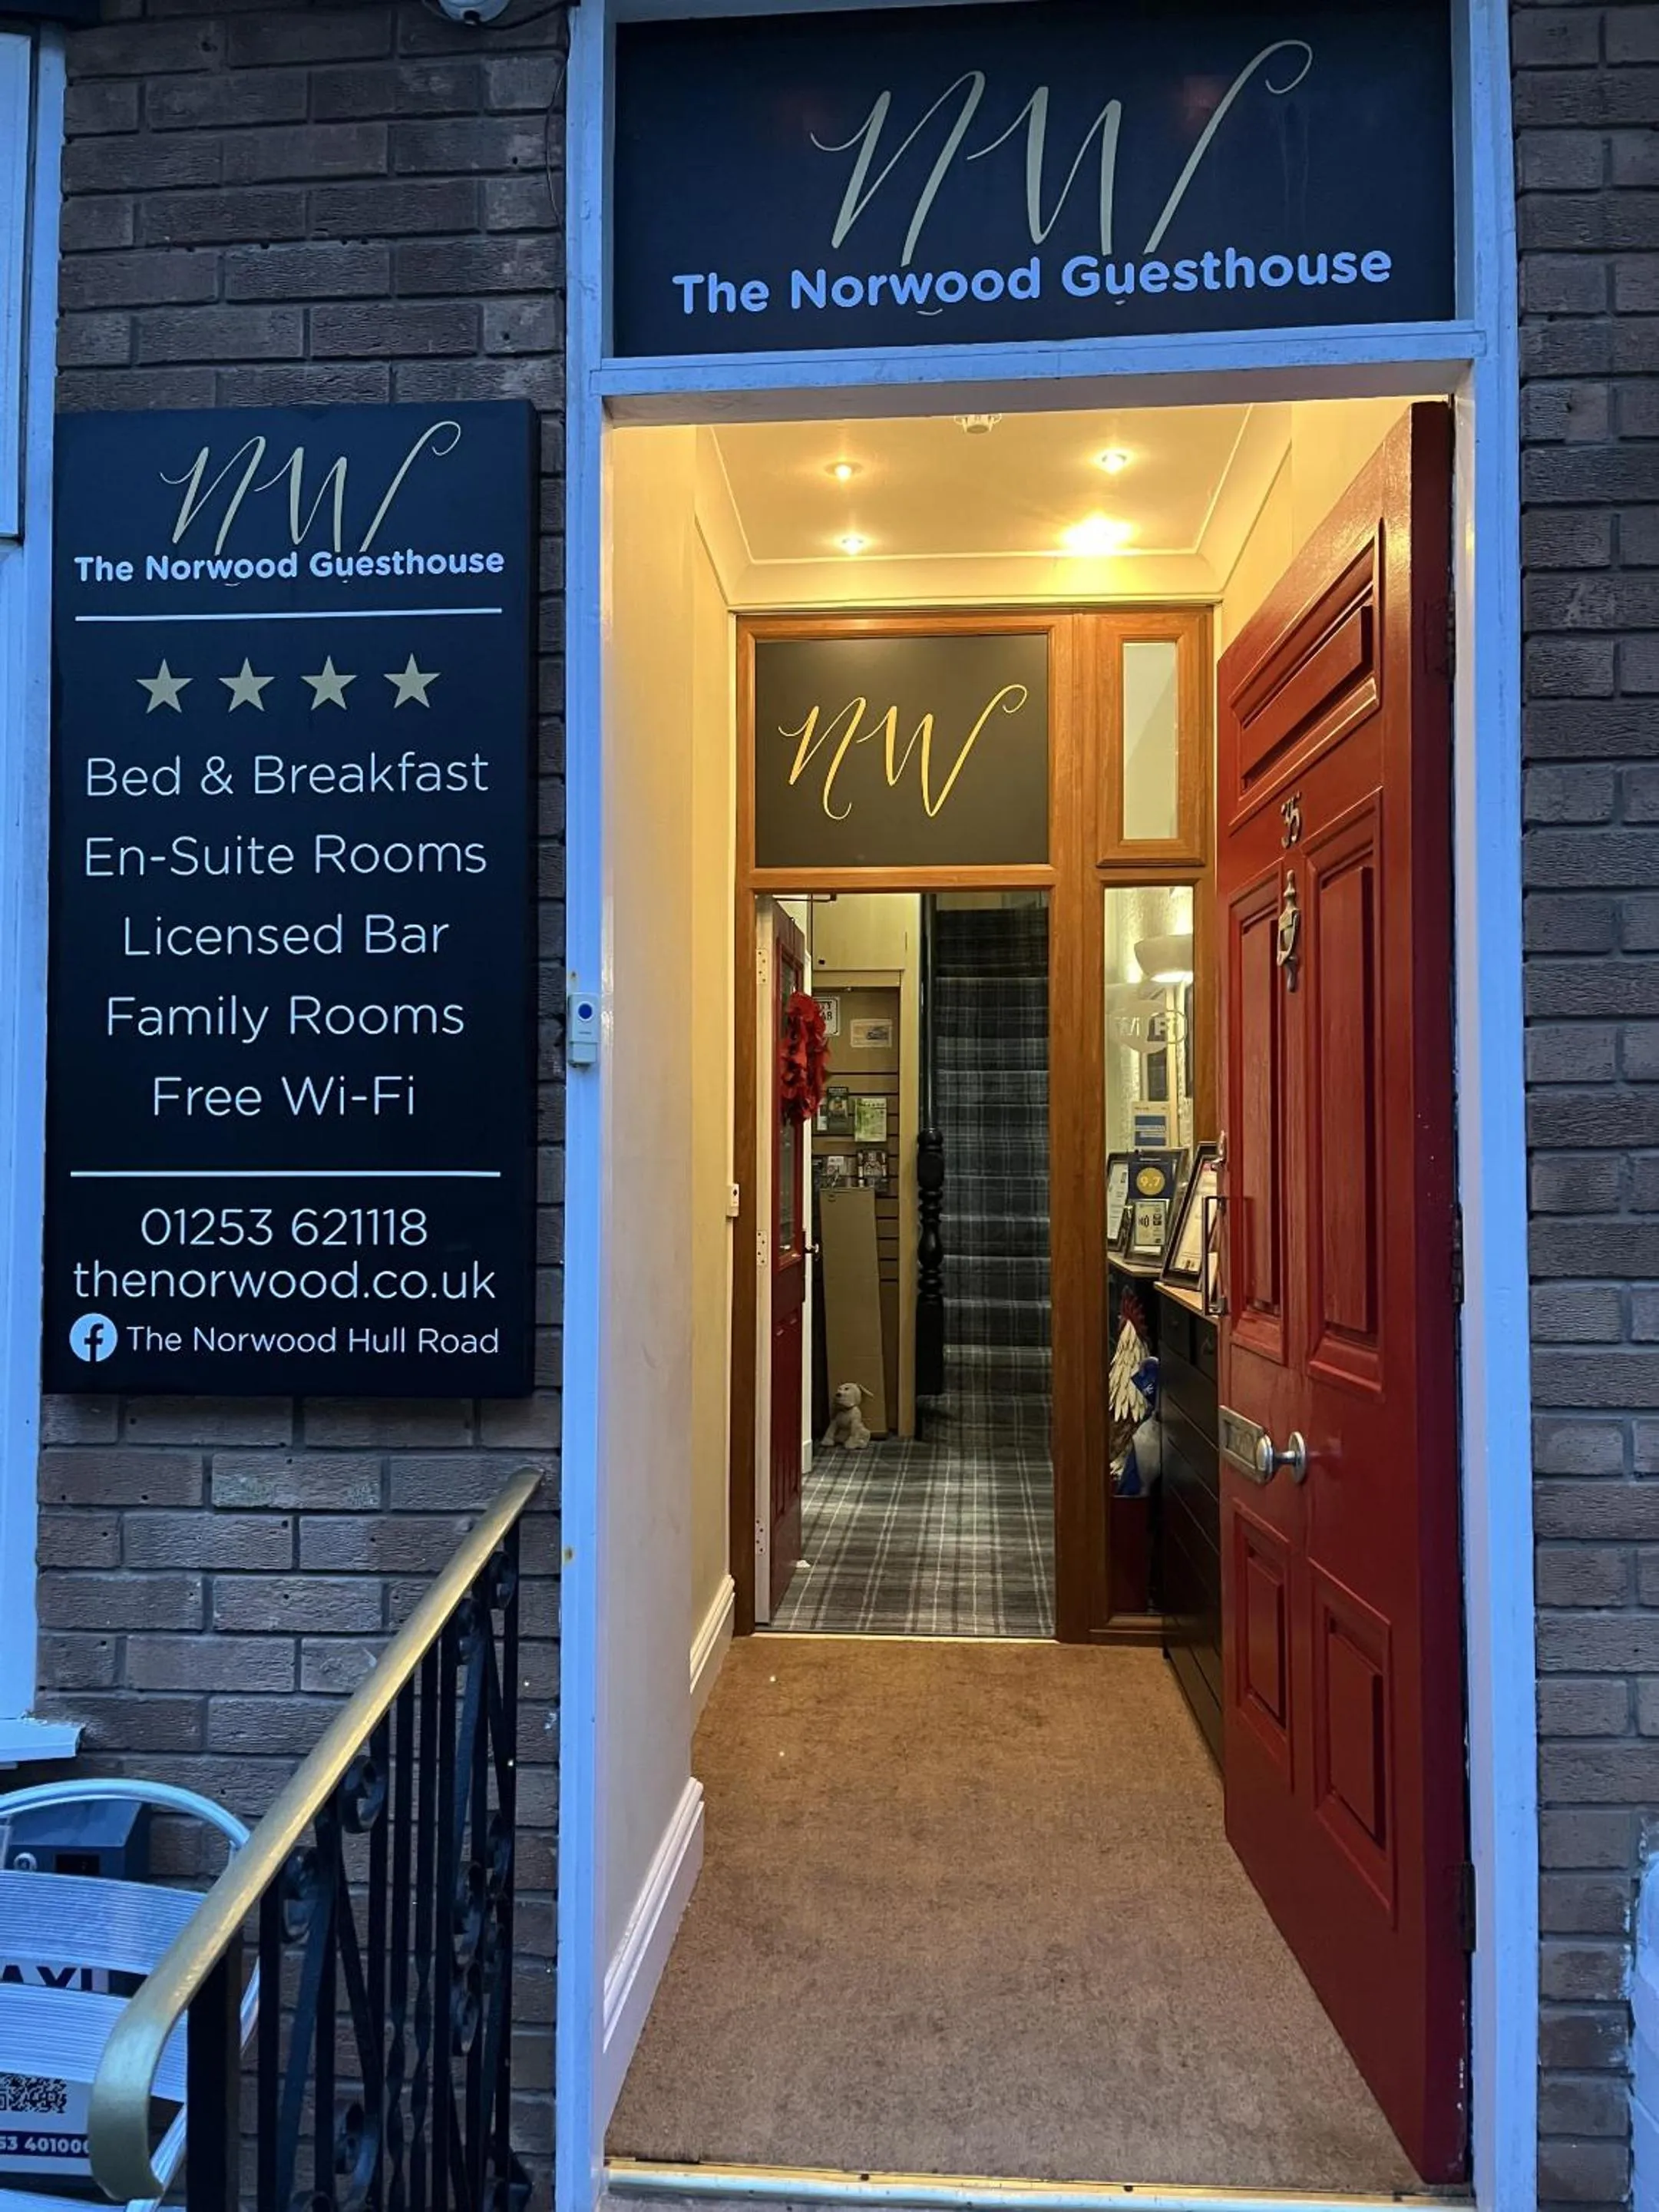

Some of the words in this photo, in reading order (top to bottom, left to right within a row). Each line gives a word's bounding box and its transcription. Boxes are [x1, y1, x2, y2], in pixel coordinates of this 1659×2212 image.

[672, 272, 769, 315] The
[791, 257, 1040, 309] Norwood
[1061, 246, 1392, 298] Guesthouse
[74, 555, 134, 582] The
[146, 551, 298, 580] Norwood
[309, 548, 505, 577] Guesthouse
[87, 755, 180, 796] Bed
[200, 756, 234, 795] &
[254, 751, 489, 794] Breakfast
[86, 835, 294, 876] En-Suite
[315, 834, 487, 874] Rooms
[124, 913, 342, 956] Licensed
[365, 914, 449, 954] Bar
[107, 994, 269, 1044] Family
[290, 995, 464, 1035] Rooms
[154, 1076, 262, 1116] Free
[281, 1075, 414, 1116] Wi-Fi
[1139, 1175, 1162, 1187] 9.7
[140, 1208, 273, 1246] 01253
[291, 1208, 428, 1246] 621118
[73, 1259, 496, 1299] thenorwood.co.uk
[126, 1326, 182, 1352] The
[193, 1326, 336, 1353] Norwood
[349, 1326, 405, 1354] Hull
[418, 1328, 498, 1354] Road
